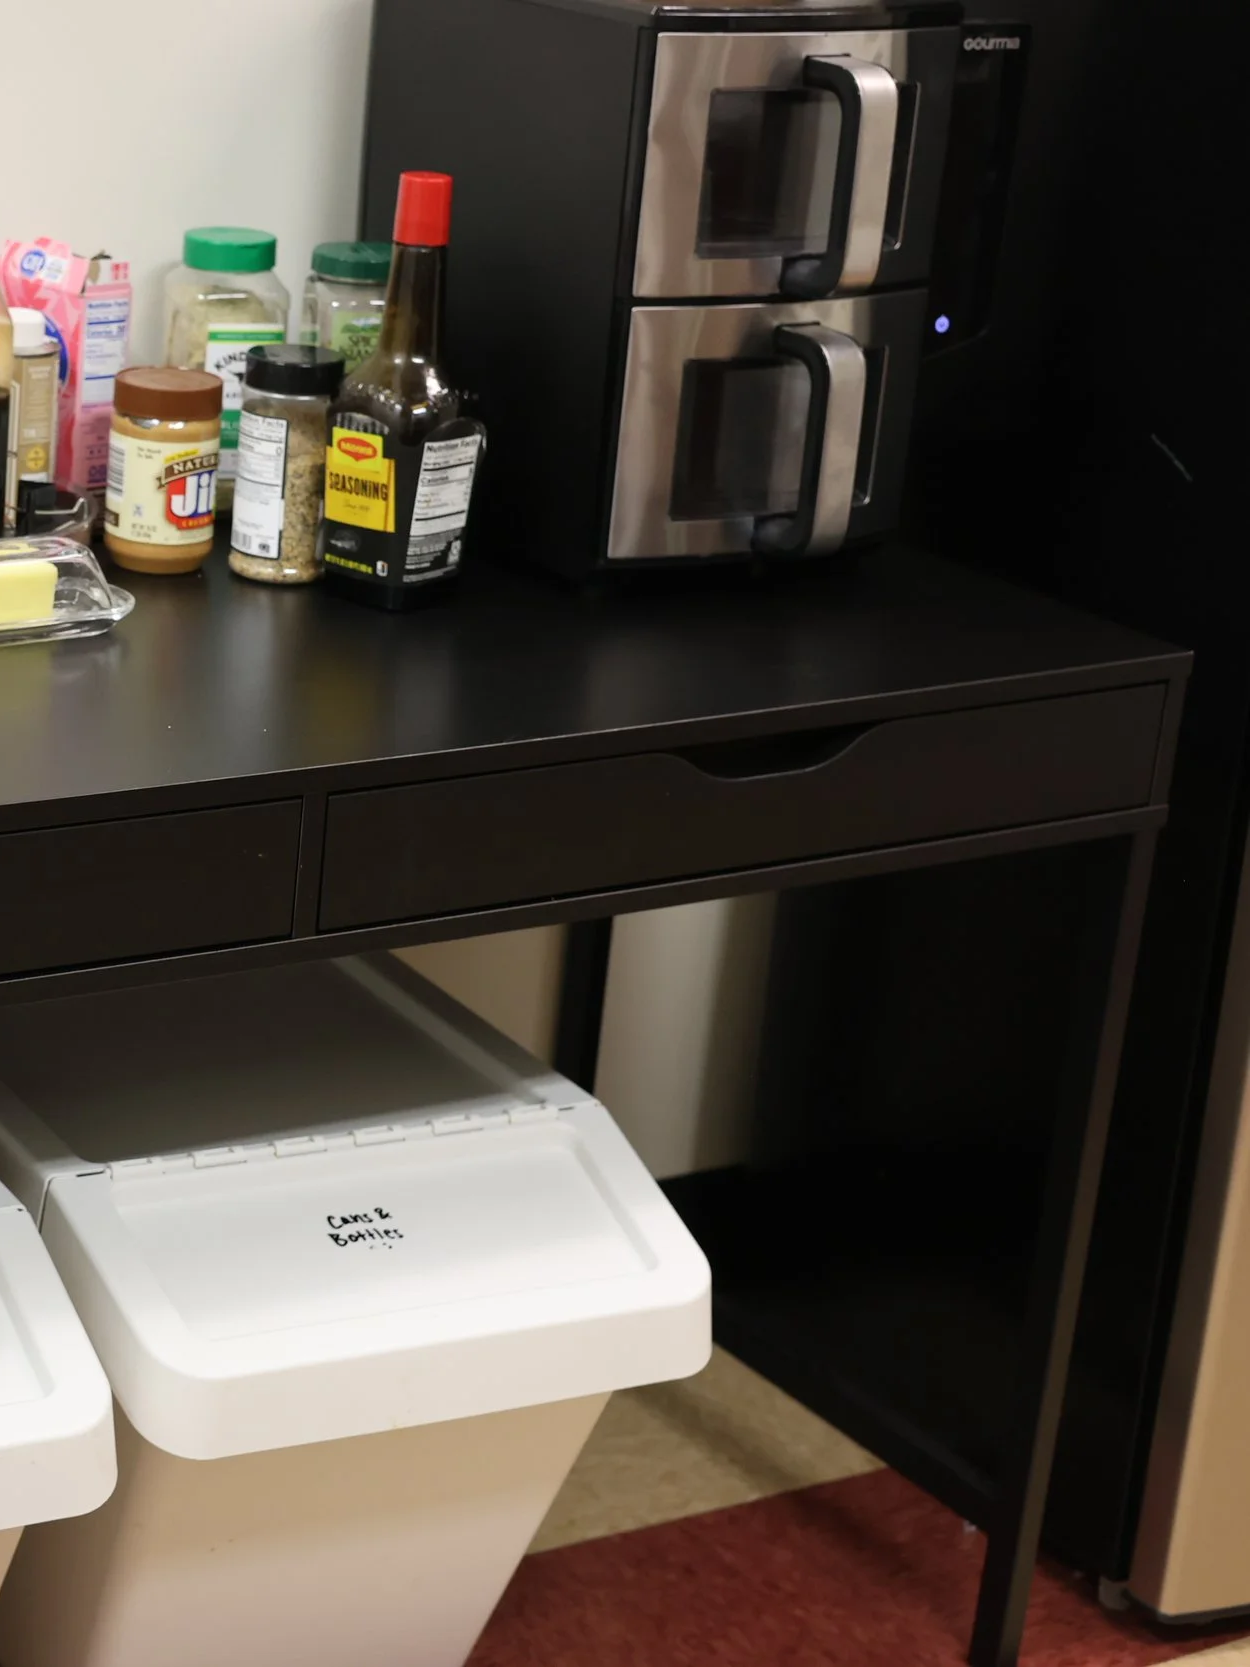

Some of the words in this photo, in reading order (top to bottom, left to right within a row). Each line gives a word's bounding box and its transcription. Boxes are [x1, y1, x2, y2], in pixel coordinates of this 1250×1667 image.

[214, 351, 247, 370] KIND
[327, 1213, 374, 1229] Cans
[328, 1228, 403, 1247] Bottles
